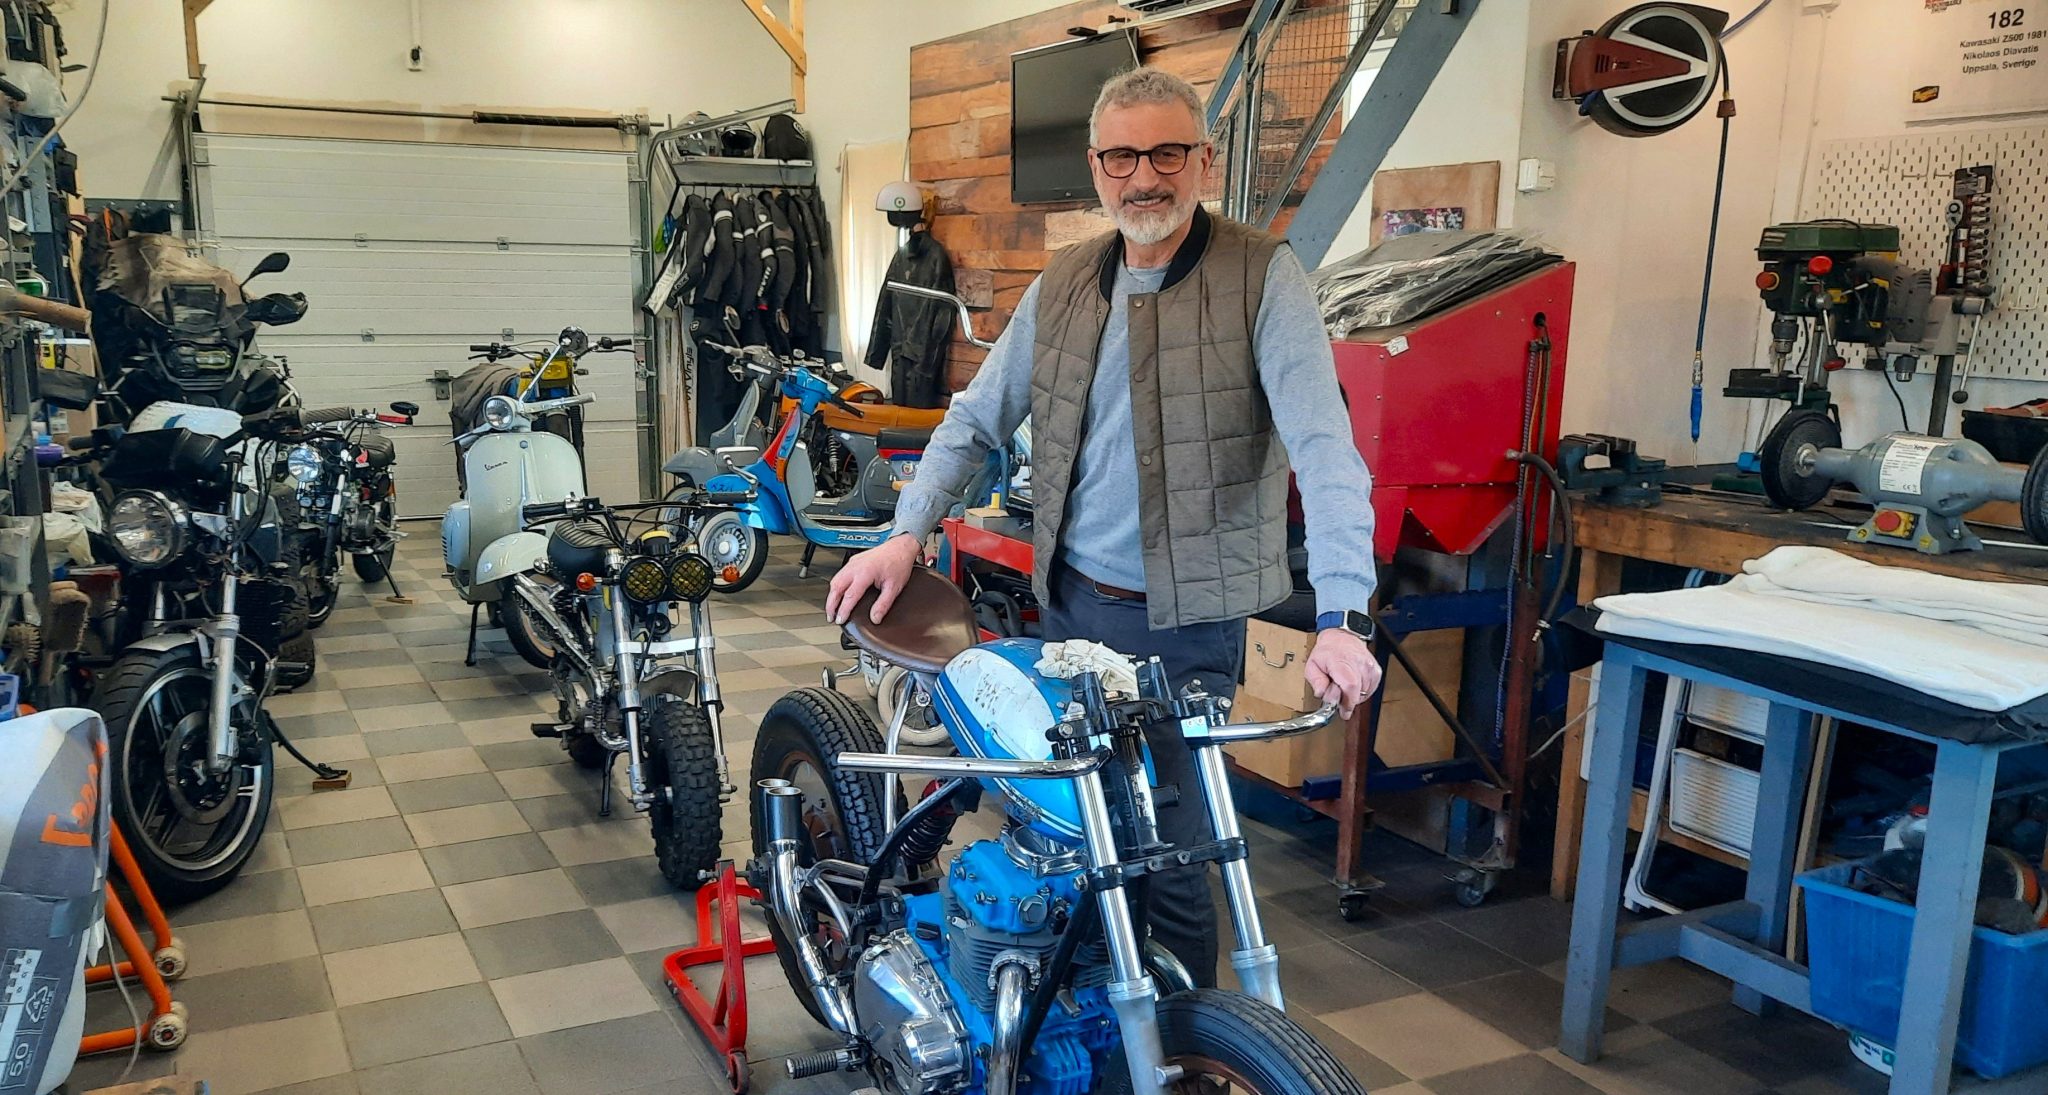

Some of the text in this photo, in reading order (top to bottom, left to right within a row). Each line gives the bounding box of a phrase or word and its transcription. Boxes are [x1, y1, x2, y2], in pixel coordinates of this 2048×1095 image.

[1987, 8, 2025, 30] 182
[1959, 29, 2048, 48] Kawasaki Z500 1981
[1962, 44, 2040, 60] Nikolaos Diavatis
[1962, 59, 2037, 74] Uppsala, Sverige
[9, 1042, 29, 1077] 50
